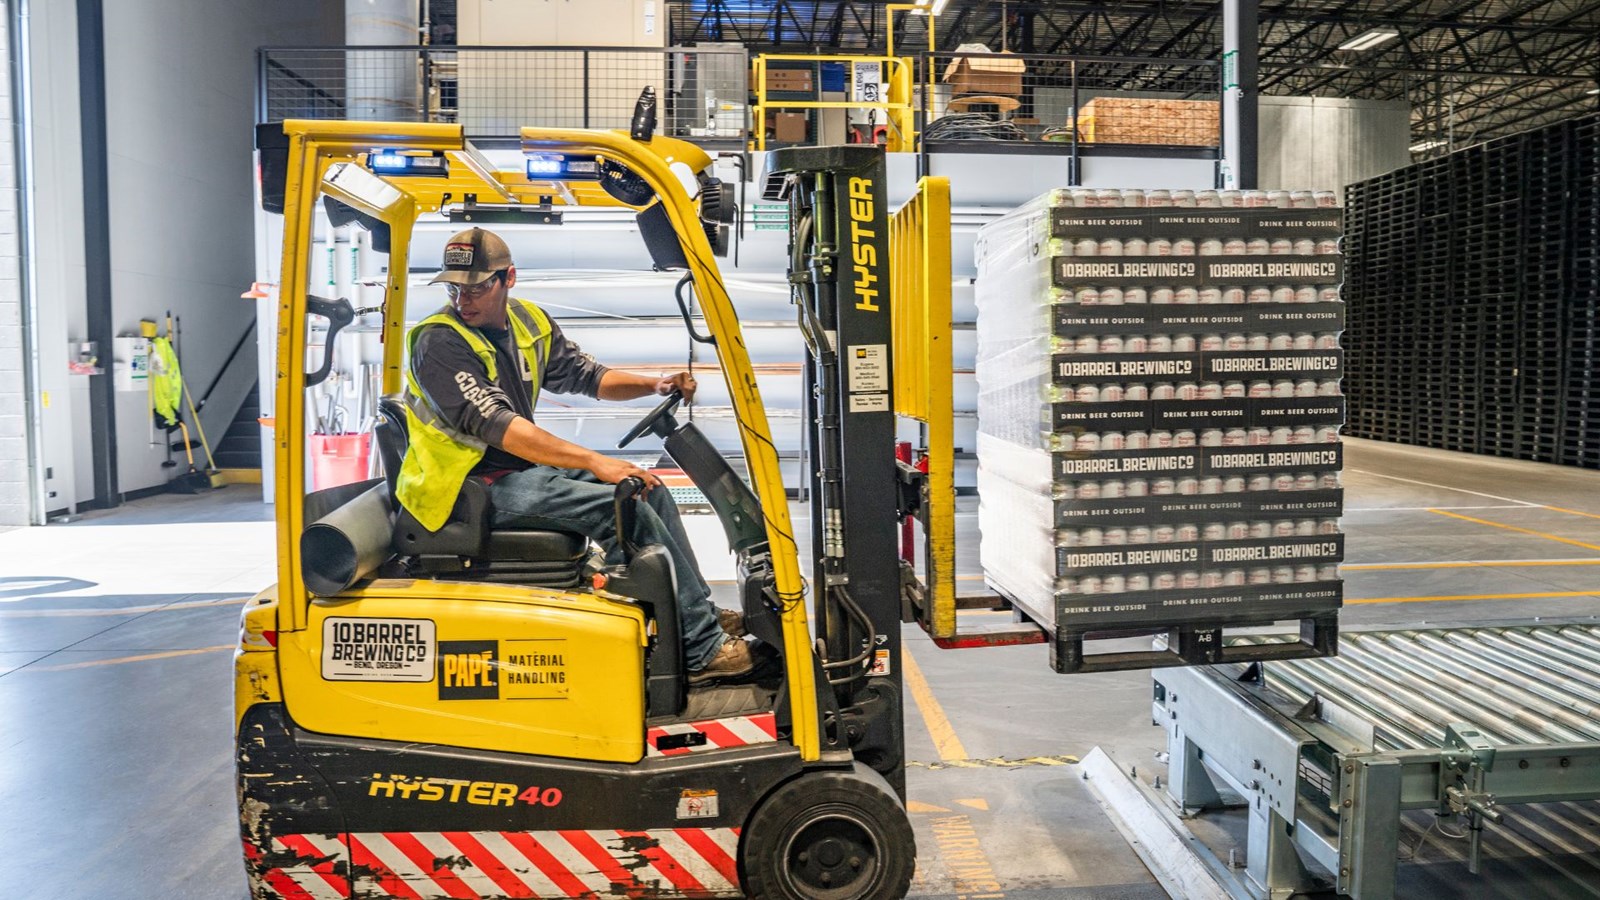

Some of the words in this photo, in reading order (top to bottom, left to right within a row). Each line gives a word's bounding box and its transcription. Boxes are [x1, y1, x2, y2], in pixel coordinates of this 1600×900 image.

[850, 176, 880, 312] HYSTER
[332, 622, 351, 643] 10
[353, 623, 426, 644] BARREL
[1198, 634, 1212, 642] A-B
[332, 644, 404, 661] BREWING
[509, 654, 564, 667] MATERIAL
[444, 651, 493, 687] PAPÉ
[508, 672, 565, 684] HANDLING
[368, 772, 518, 806] HYSTER
[518, 786, 562, 806] 40
